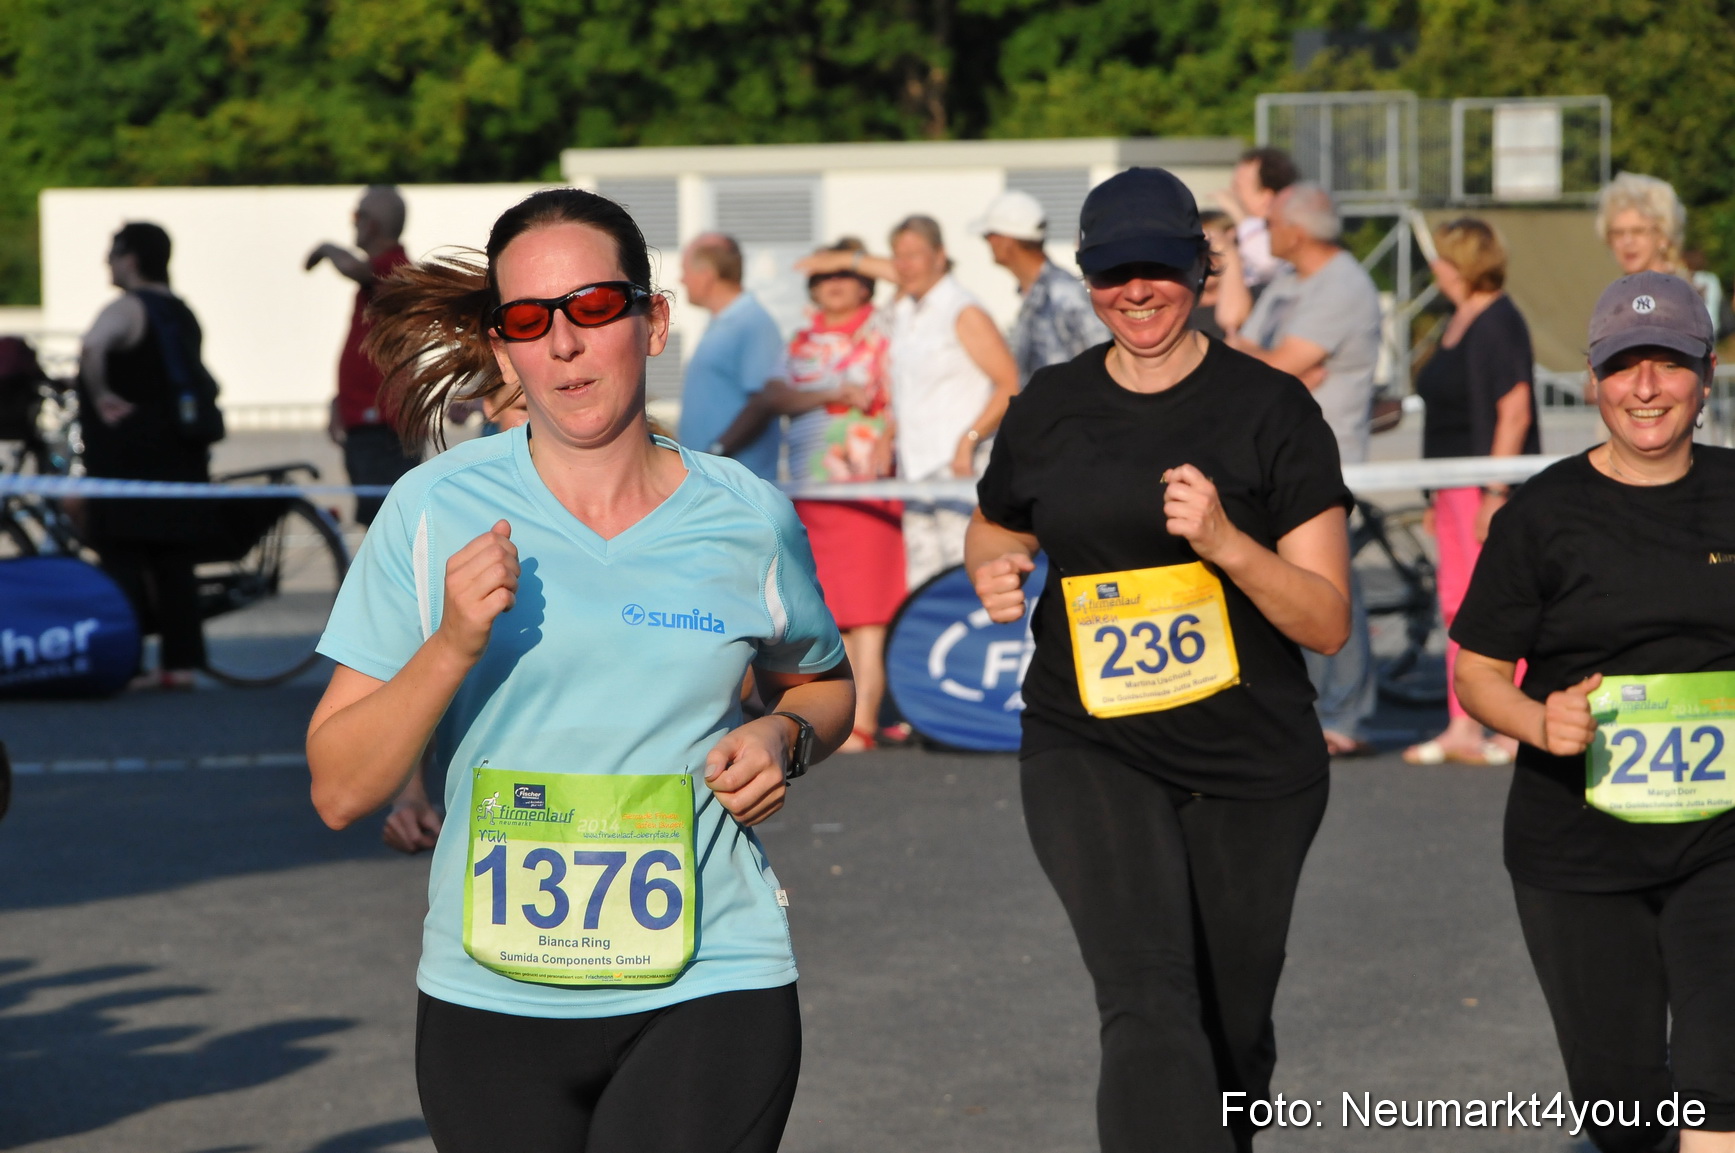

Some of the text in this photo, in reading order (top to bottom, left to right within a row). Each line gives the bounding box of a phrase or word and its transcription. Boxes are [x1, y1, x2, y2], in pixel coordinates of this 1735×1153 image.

[1089, 593, 1142, 608] firmenlauf
[648, 608, 725, 634] sumida
[0, 617, 99, 668] her
[1094, 613, 1206, 679] 236
[1610, 725, 1726, 785] 242
[1648, 788, 1676, 797] Margit
[500, 805, 575, 823] firmenlauf
[577, 819, 620, 833] 2014
[474, 845, 683, 931] 1376
[538, 935, 611, 950] Bianca Ring
[500, 951, 651, 967] Sumida Components GmbH
